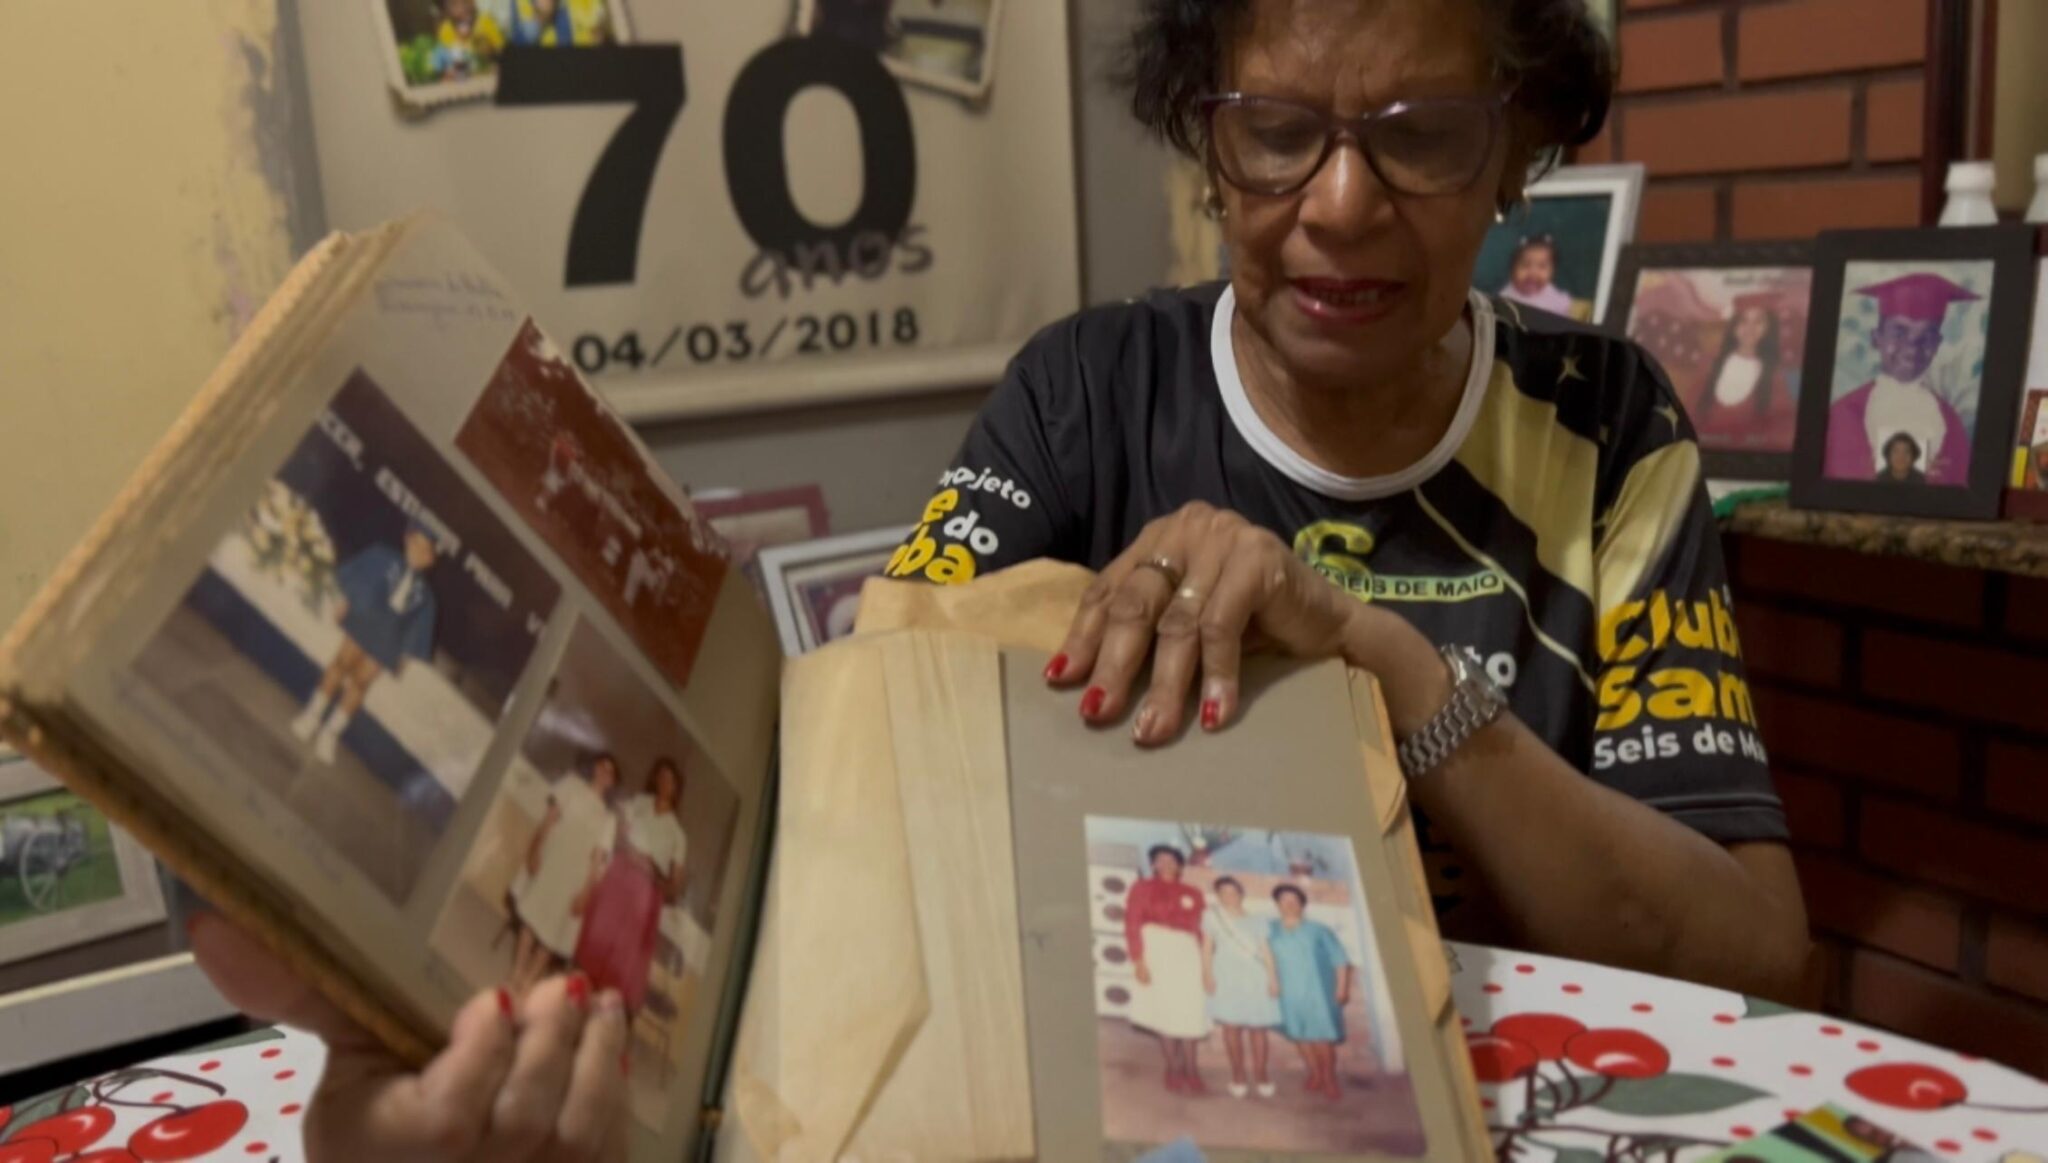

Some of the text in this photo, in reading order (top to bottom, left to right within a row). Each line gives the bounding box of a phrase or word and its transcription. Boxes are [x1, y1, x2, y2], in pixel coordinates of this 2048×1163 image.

[494, 33, 917, 289] 70
[740, 221, 935, 302] anos
[571, 308, 920, 375] 04/03/2018
[939, 467, 1032, 509] rojeto
[943, 510, 999, 555] do
[1394, 579, 1428, 595] DE
[1435, 573, 1499, 597] MAIO
[1598, 587, 1742, 664] Club
[1594, 724, 1681, 770] Seis
[1692, 722, 1735, 755] de
